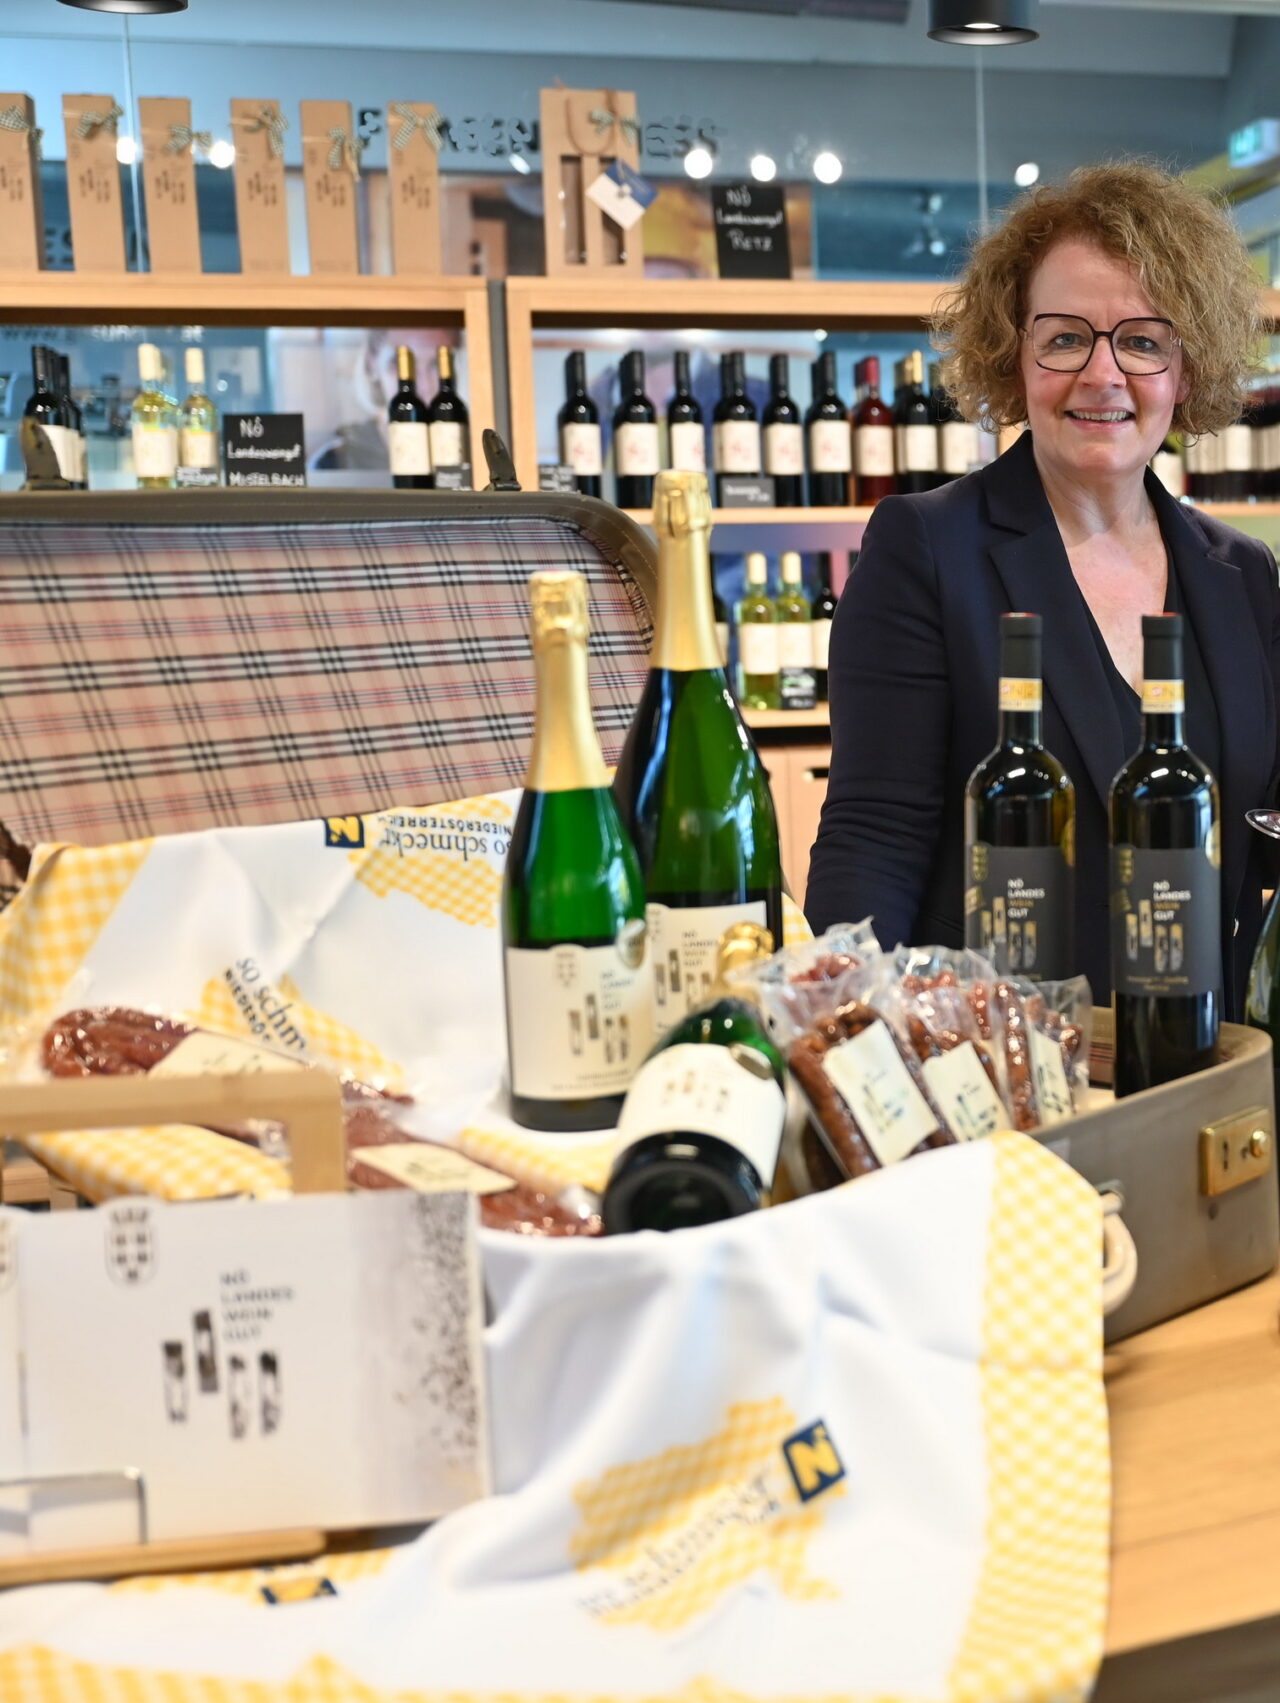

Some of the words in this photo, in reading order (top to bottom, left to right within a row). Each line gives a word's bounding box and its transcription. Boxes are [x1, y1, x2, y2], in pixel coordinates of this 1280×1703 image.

[1008, 888, 1045, 899] LANDES
[1153, 890, 1191, 901] LANDES
[1008, 908, 1029, 918] GUT
[1153, 910, 1175, 921] GUT
